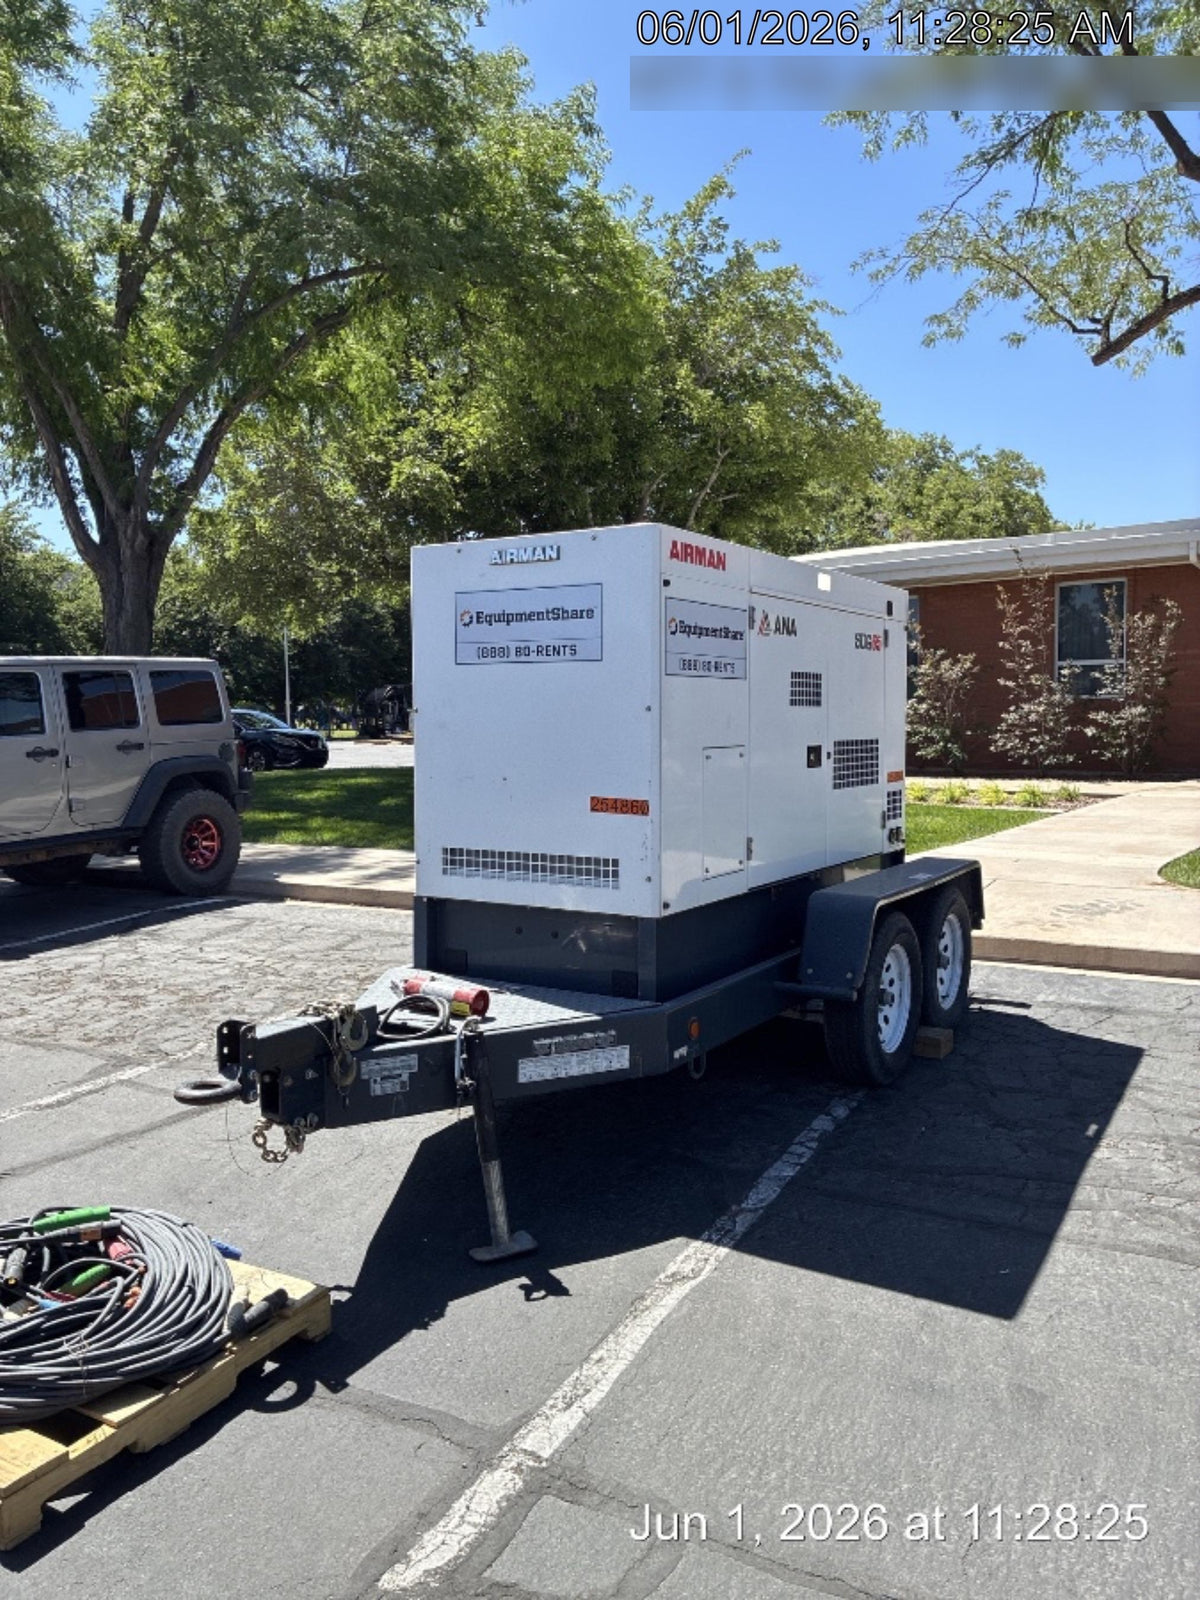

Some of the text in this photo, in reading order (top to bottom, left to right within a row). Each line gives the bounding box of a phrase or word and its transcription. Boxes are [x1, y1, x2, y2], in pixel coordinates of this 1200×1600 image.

[489, 545, 561, 565] AIRMAN
[669, 540, 726, 571] AIRMAN
[475, 607, 595, 626] EquipmentShare
[774, 615, 798, 637] ANA
